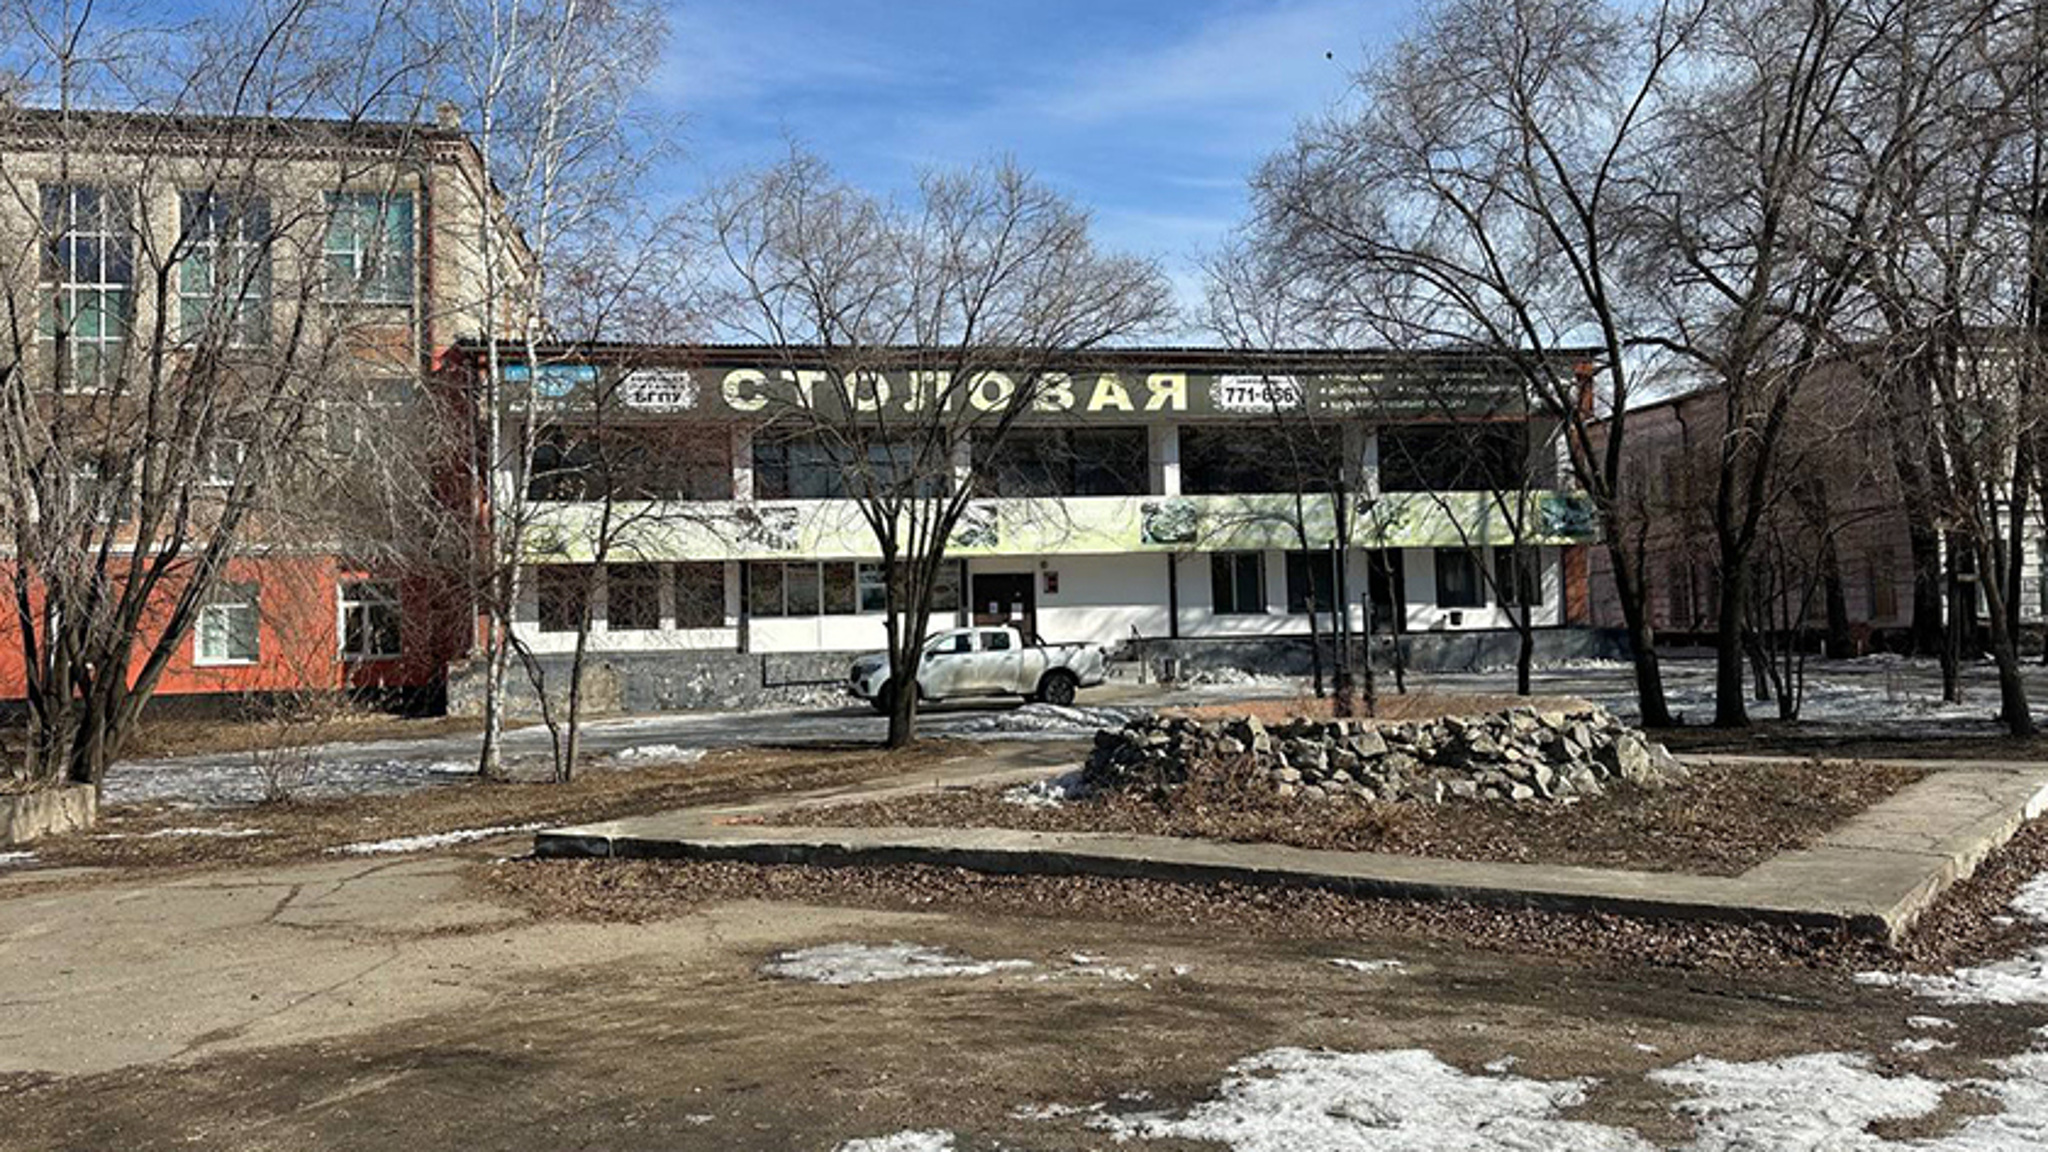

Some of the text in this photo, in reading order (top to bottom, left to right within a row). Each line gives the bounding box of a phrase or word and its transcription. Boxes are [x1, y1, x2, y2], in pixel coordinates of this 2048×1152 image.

[635, 391, 681, 403] БГПУ
[722, 368, 1187, 411] СТОЛОВАЯ
[1226, 387, 1294, 403] 771-656
